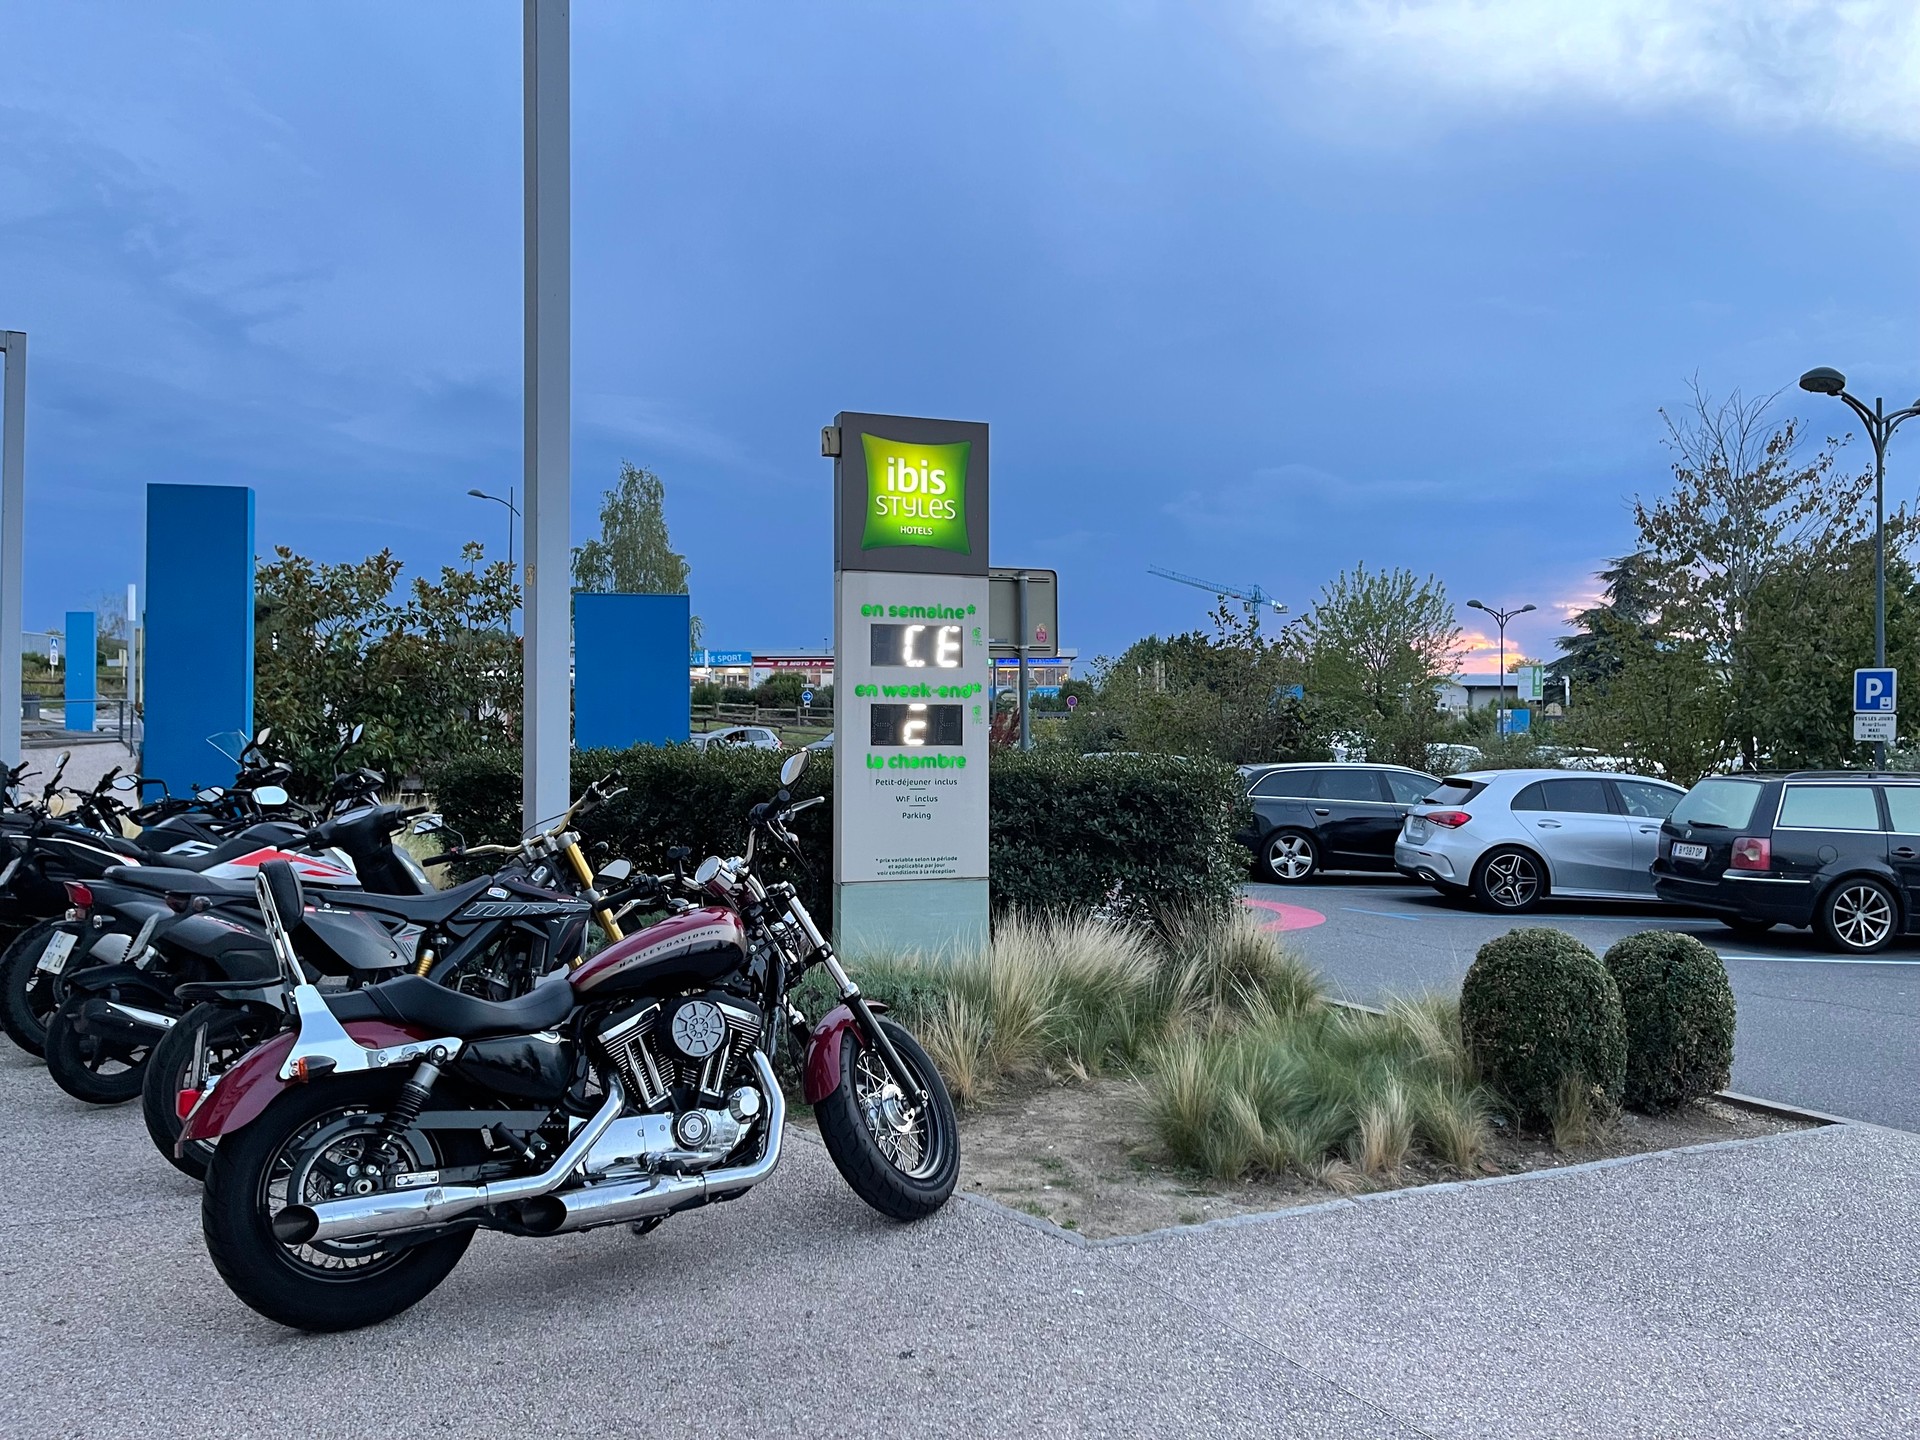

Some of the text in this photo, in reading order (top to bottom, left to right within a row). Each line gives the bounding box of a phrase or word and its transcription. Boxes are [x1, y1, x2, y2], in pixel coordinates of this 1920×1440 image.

[888, 457, 947, 495] ibis
[900, 526, 933, 535] HOTELS
[861, 604, 884, 617] en
[717, 654, 742, 663] SPORT
[855, 684, 878, 697] en
[1866, 678, 1883, 703] P
[866, 753, 966, 769] la chambre
[875, 778, 931, 787] Petit-déjeuner
[902, 812, 931, 820] Parking
[619, 930, 721, 968] HARLEY-DAVIDSON
